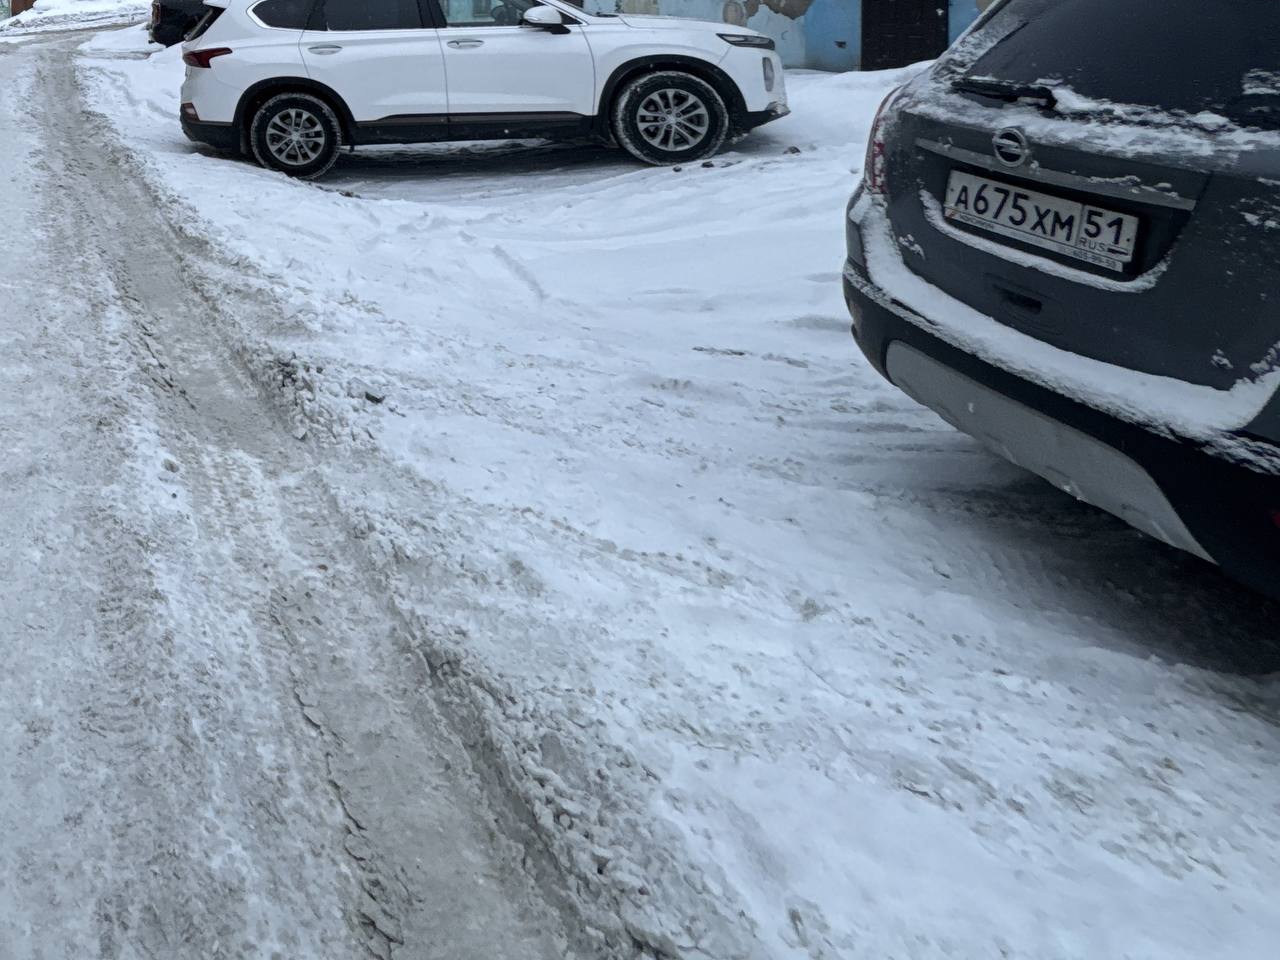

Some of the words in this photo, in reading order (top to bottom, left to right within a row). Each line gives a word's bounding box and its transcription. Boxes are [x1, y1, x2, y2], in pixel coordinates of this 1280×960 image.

[954, 183, 1075, 242] А675ХМ
[1083, 209, 1125, 246] 51
[1077, 237, 1107, 252] RUS
